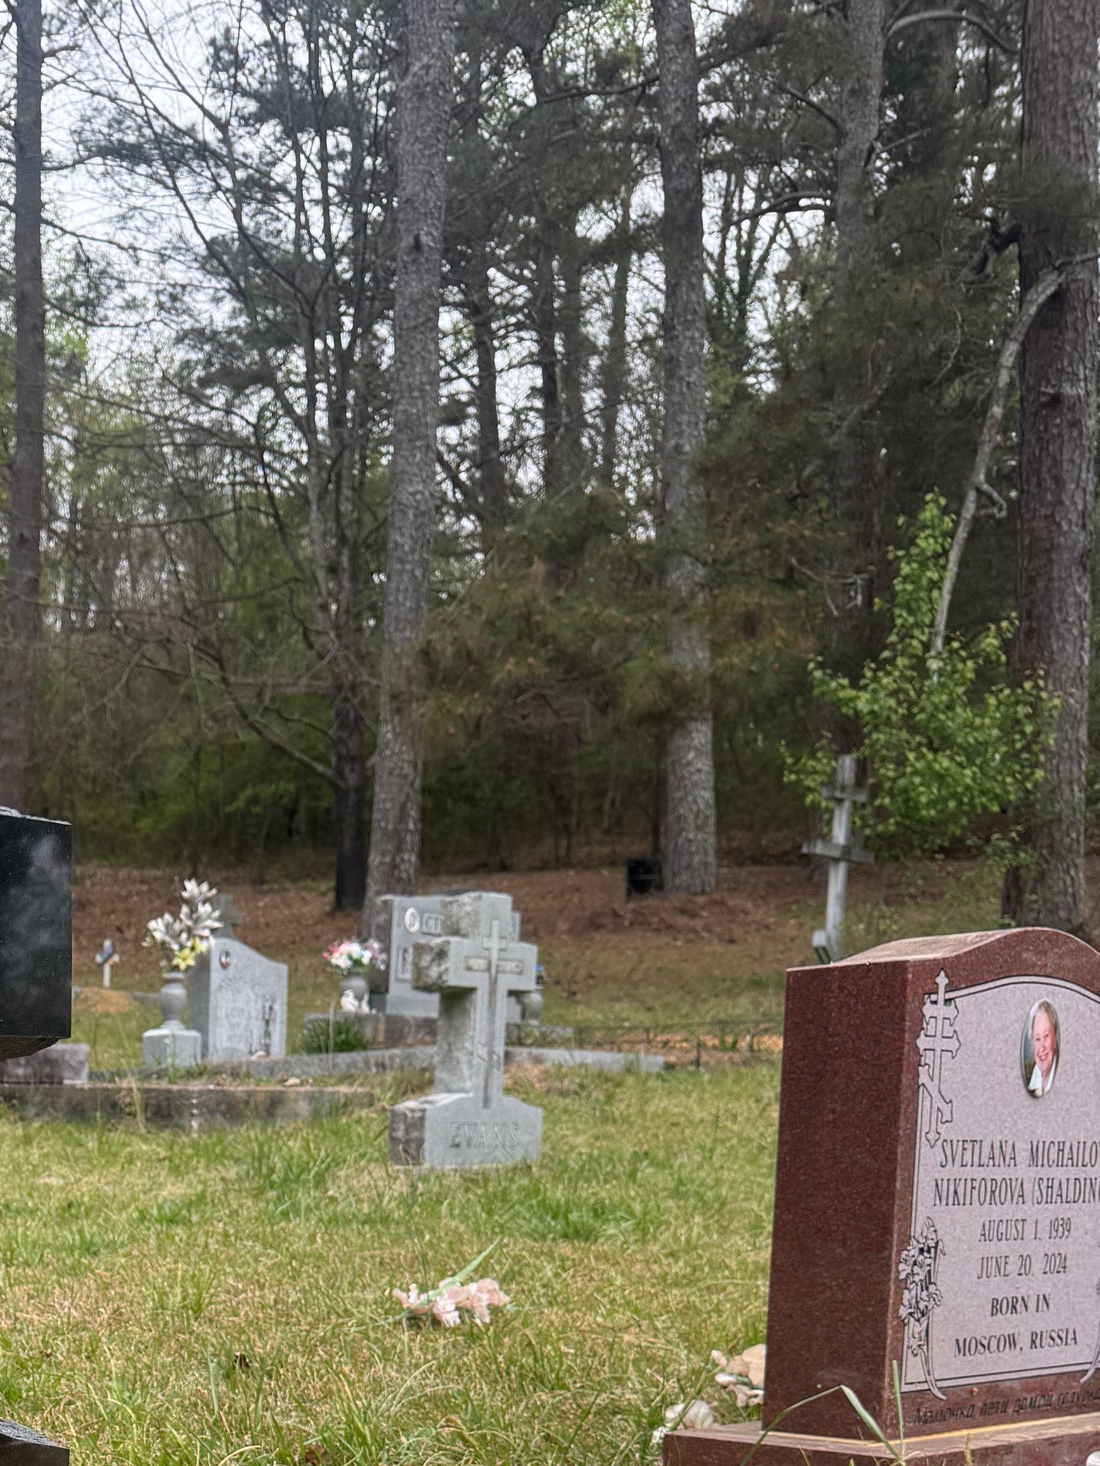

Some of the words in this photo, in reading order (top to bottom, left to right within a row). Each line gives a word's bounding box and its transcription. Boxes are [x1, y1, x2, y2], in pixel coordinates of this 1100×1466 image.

[450, 1121, 519, 1150] EVANS
[940, 1138, 1018, 1168] SVETLANA
[1027, 1139, 1100, 1168] MICHAILO
[933, 1176, 1026, 1207] NIKIFOROVA
[1031, 1176, 1100, 1206] (SHALDIN
[978, 1218, 1027, 1242] AUGUST
[1048, 1216, 1072, 1240] 1939
[977, 1255, 1010, 1279] JUNE
[1042, 1252, 1068, 1275] 2024
[990, 1294, 1030, 1317] BORN
[1035, 1293, 1051, 1313] IN
[953, 1332, 1024, 1357] MOSCOW,
[1030, 1328, 1078, 1350] RUSSIA
